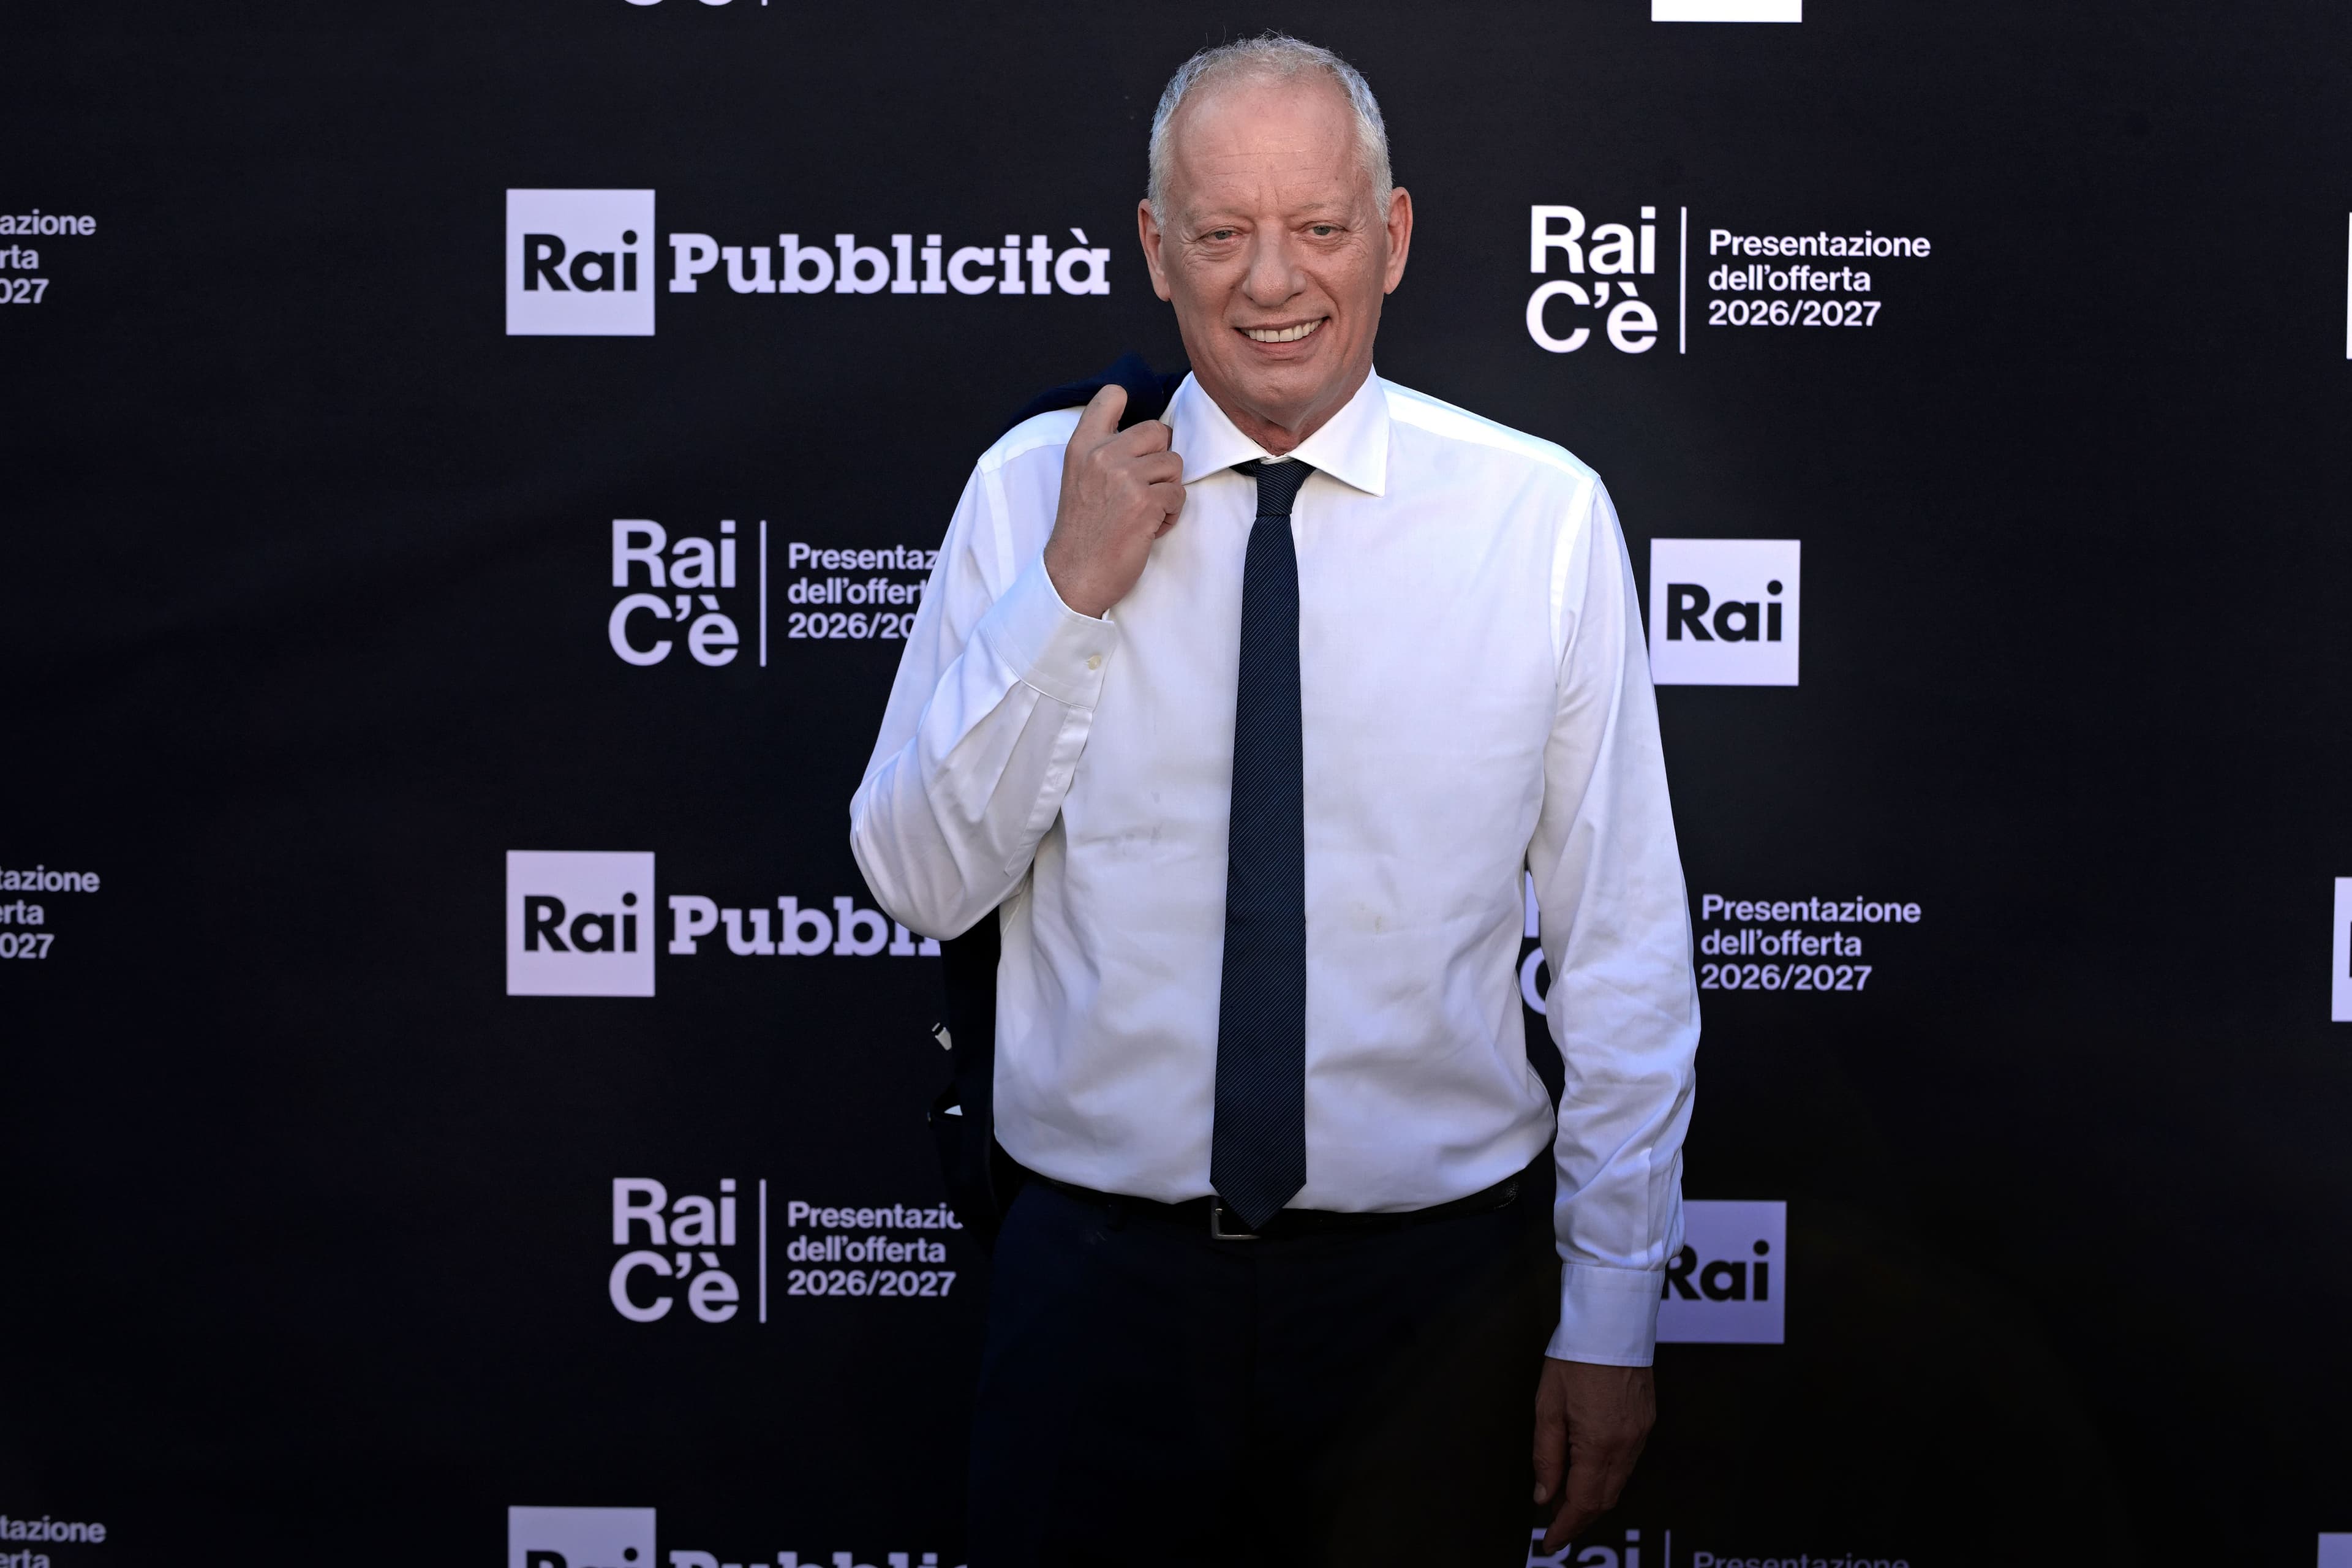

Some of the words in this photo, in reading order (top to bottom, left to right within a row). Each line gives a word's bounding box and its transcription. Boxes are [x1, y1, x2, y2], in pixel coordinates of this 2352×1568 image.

[524, 230, 638, 293] Rai
[669, 227, 1110, 295] Pubblicità
[1530, 205, 1656, 275] Rai
[1709, 228, 1931, 257] Presentazione
[1708, 264, 1871, 292] dell’offerta
[1526, 280, 1658, 354] C’è
[1708, 299, 1882, 326] 2026/2027
[612, 519, 736, 589] Rai
[608, 593, 739, 667] C’è
[1667, 579, 1783, 643] Rai
[524, 892, 637, 953] Rai
[1702, 894, 1921, 923] Presentazione
[1700, 928, 1862, 957] dell’offerta
[1701, 963, 1872, 991] 2026/2027
[612, 1177, 736, 1246] Rai
[786, 1234, 946, 1263] dell’offerta
[609, 1250, 739, 1323] C’è
[787, 1269, 957, 1297] 2026/2027
